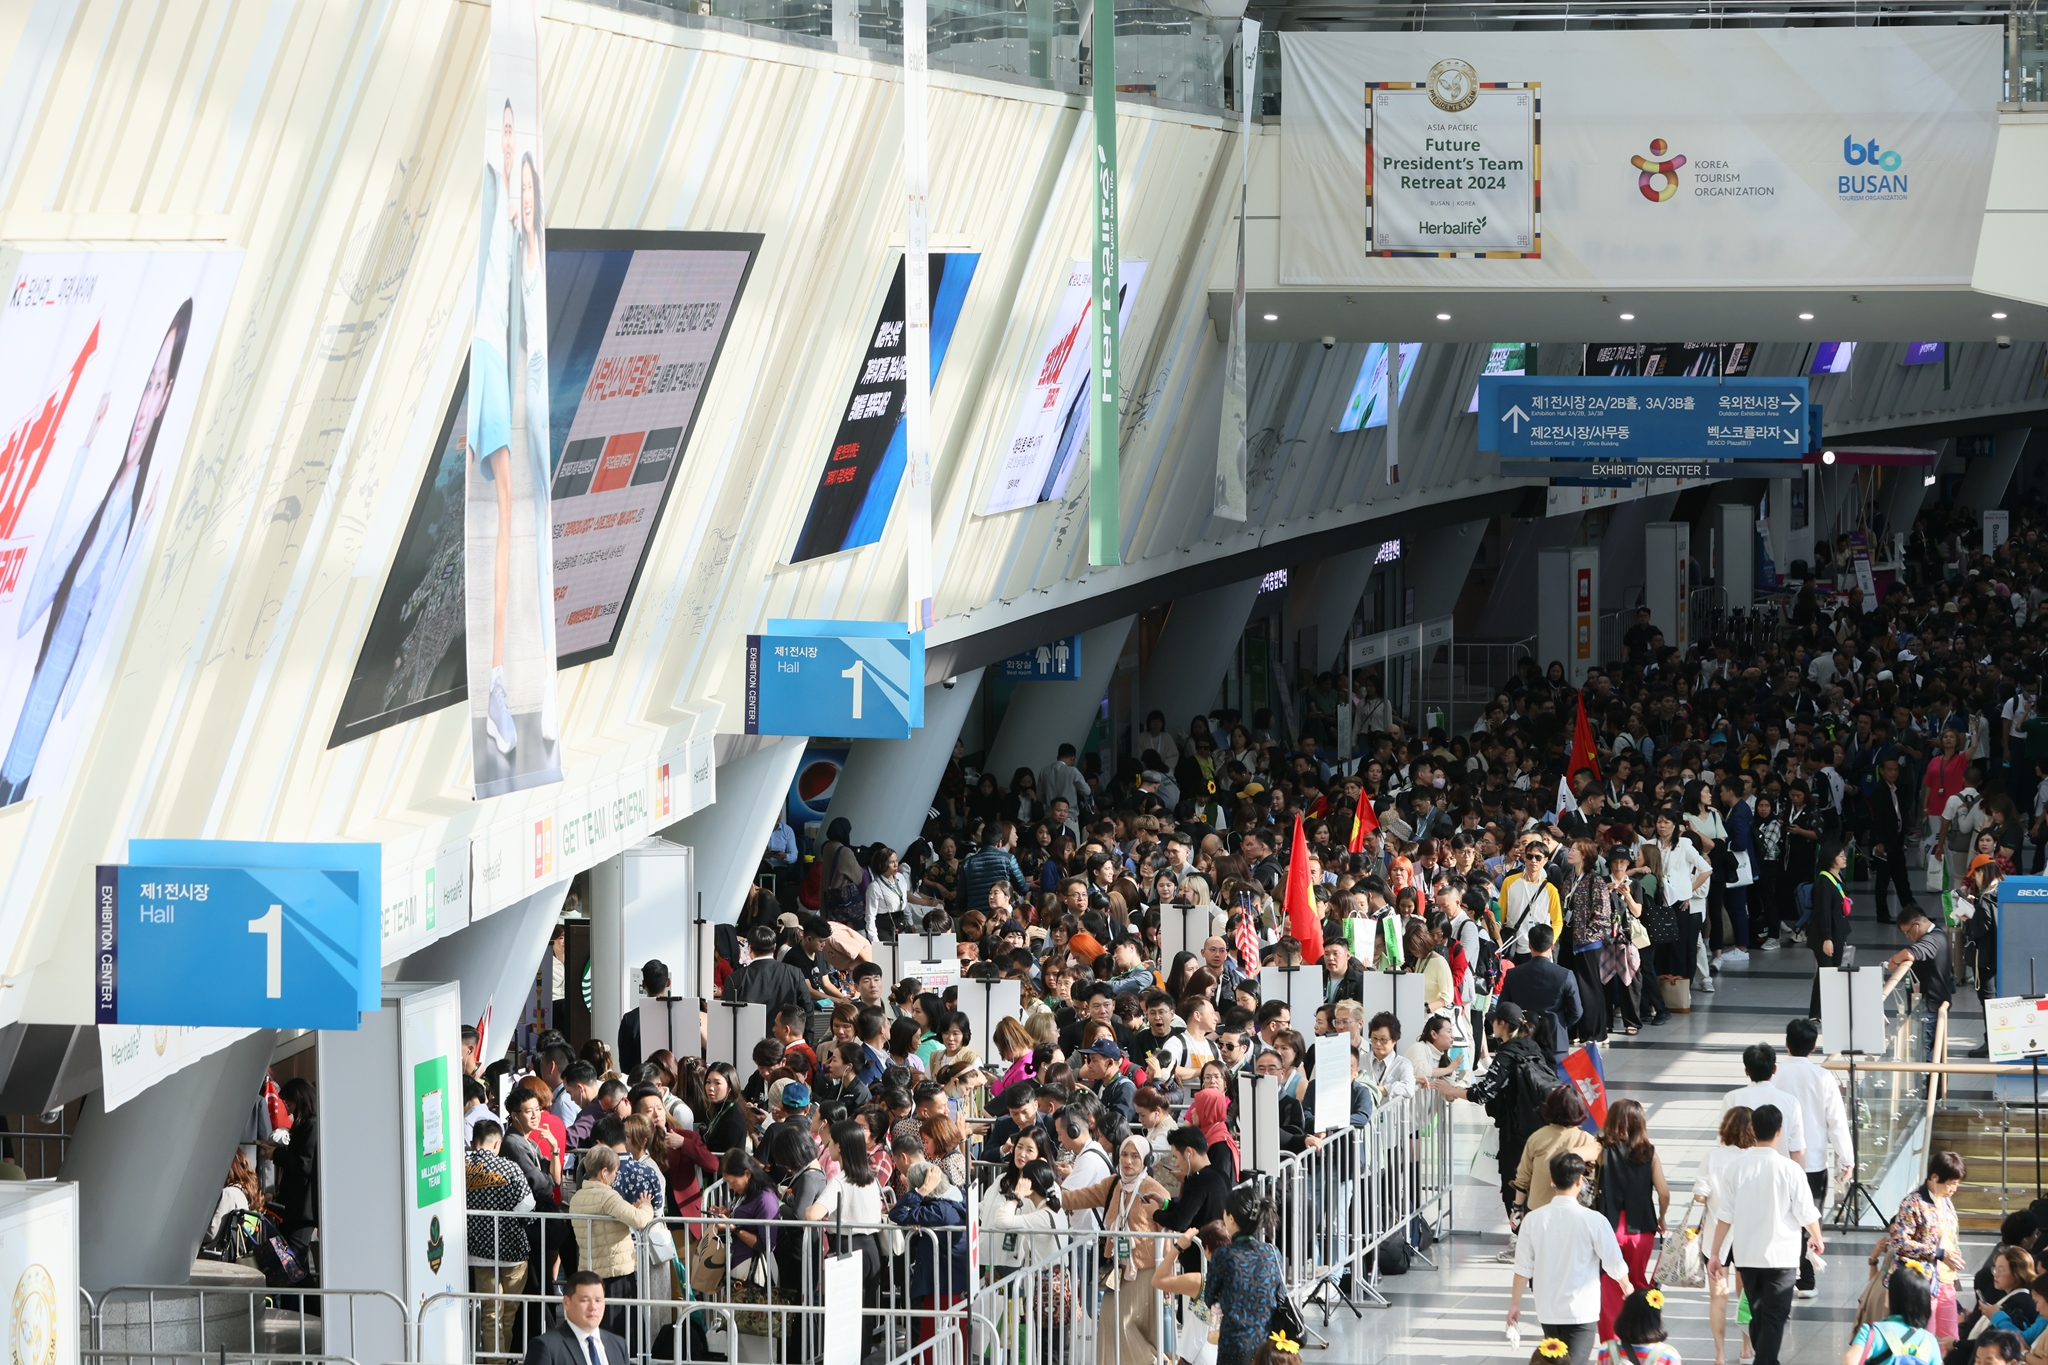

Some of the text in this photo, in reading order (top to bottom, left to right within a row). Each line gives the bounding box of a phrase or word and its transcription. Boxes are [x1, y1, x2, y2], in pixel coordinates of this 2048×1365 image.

[1463, 89, 1476, 107] TEAM
[1447, 124, 1478, 132] PACIFIC
[1425, 138, 1481, 151] Future
[1844, 134, 1903, 172] bto
[1479, 157, 1523, 170] Team
[1694, 160, 1729, 169] KOREA
[1401, 176, 1507, 189] Retreat 2024
[1694, 173, 1740, 183] TOURISM
[1838, 175, 1908, 194] BUSAN
[1694, 187, 1775, 196] ORGANIZATION
[1419, 220, 1482, 235] Herbalife
[1532, 395, 1696, 412] 제1전시장 2A/2B홀, 3A/3B홀
[1718, 395, 1780, 410] 옥외전시장
[1530, 425, 1630, 440] 제2전시장/사무동
[1707, 425, 1781, 440] 벡스코플라자
[1600, 440, 1620, 448] Building
[1592, 465, 1653, 476] EXHIBITION
[1656, 465, 1702, 476] CENTER
[774, 645, 818, 659] 제1전시장
[749, 647, 758, 688] EXHIBITION
[777, 660, 800, 673] Hall
[1006, 660, 1032, 669] 화장실
[841, 660, 863, 719] 1
[748, 690, 757, 720] CENTER
[562, 818, 580, 857] GET
[581, 806, 607, 848] TEAM
[612, 787, 648, 833] GENERAL
[140, 883, 209, 901] 제1전시장
[101, 885, 113, 951] EXHIBITION
[140, 905, 175, 924] Hall
[392, 894, 417, 934] TEAM
[248, 904, 282, 998] 1
[101, 953, 113, 1002] CENTER
[421, 1160, 447, 1179] MILLIONAIRE
[428, 1174, 441, 1188] TEAM
